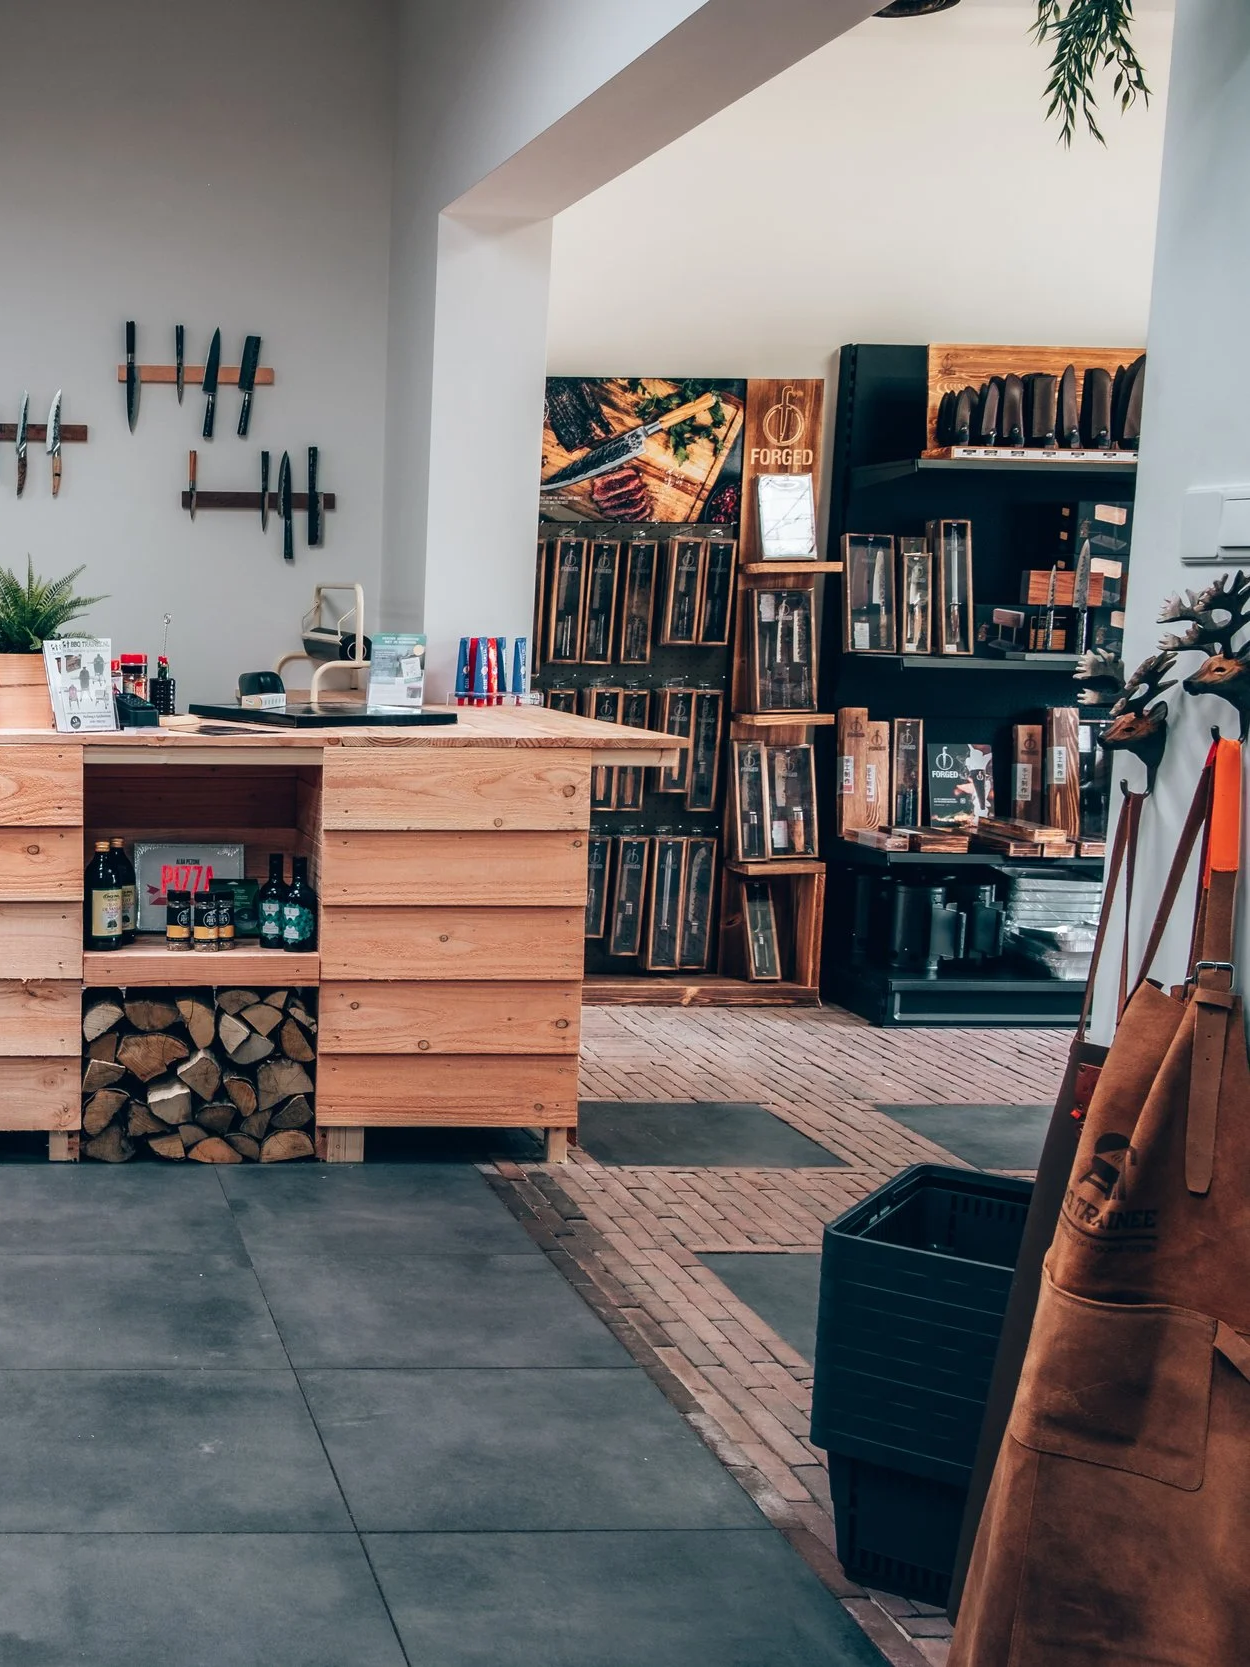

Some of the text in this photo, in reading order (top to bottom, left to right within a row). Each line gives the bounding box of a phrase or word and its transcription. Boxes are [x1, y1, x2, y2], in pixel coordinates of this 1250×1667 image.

[750, 448, 813, 466] FORGED
[931, 770, 958, 779] FORGED
[161, 864, 214, 894] PIZZA
[1074, 1197, 1158, 1231] TRAINEE
